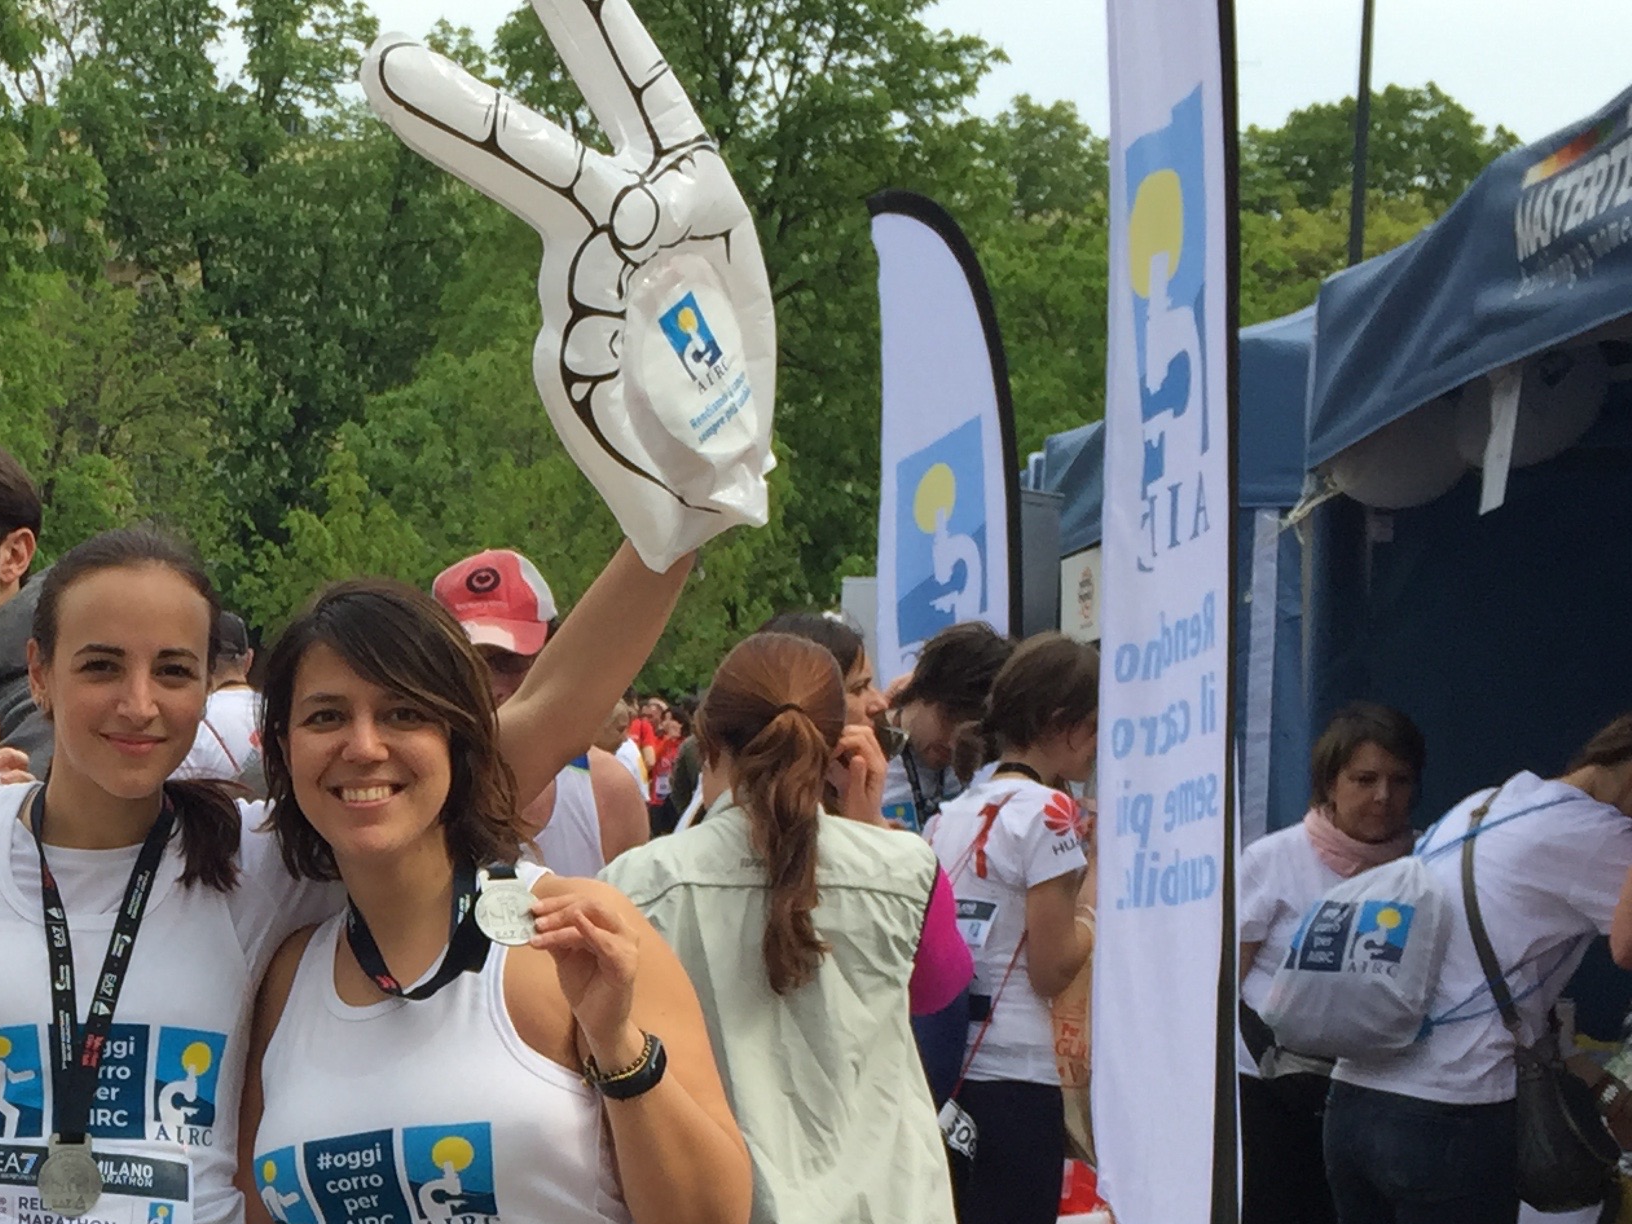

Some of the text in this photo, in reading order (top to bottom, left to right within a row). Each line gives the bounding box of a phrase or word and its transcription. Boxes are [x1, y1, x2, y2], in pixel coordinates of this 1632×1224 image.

[1348, 960, 1401, 979] AIRC
[89, 1107, 129, 1128] IRC
[155, 1123, 213, 1147] AIRC
[316, 1142, 382, 1171] #oggi
[326, 1173, 384, 1194] corro
[343, 1192, 379, 1216] per
